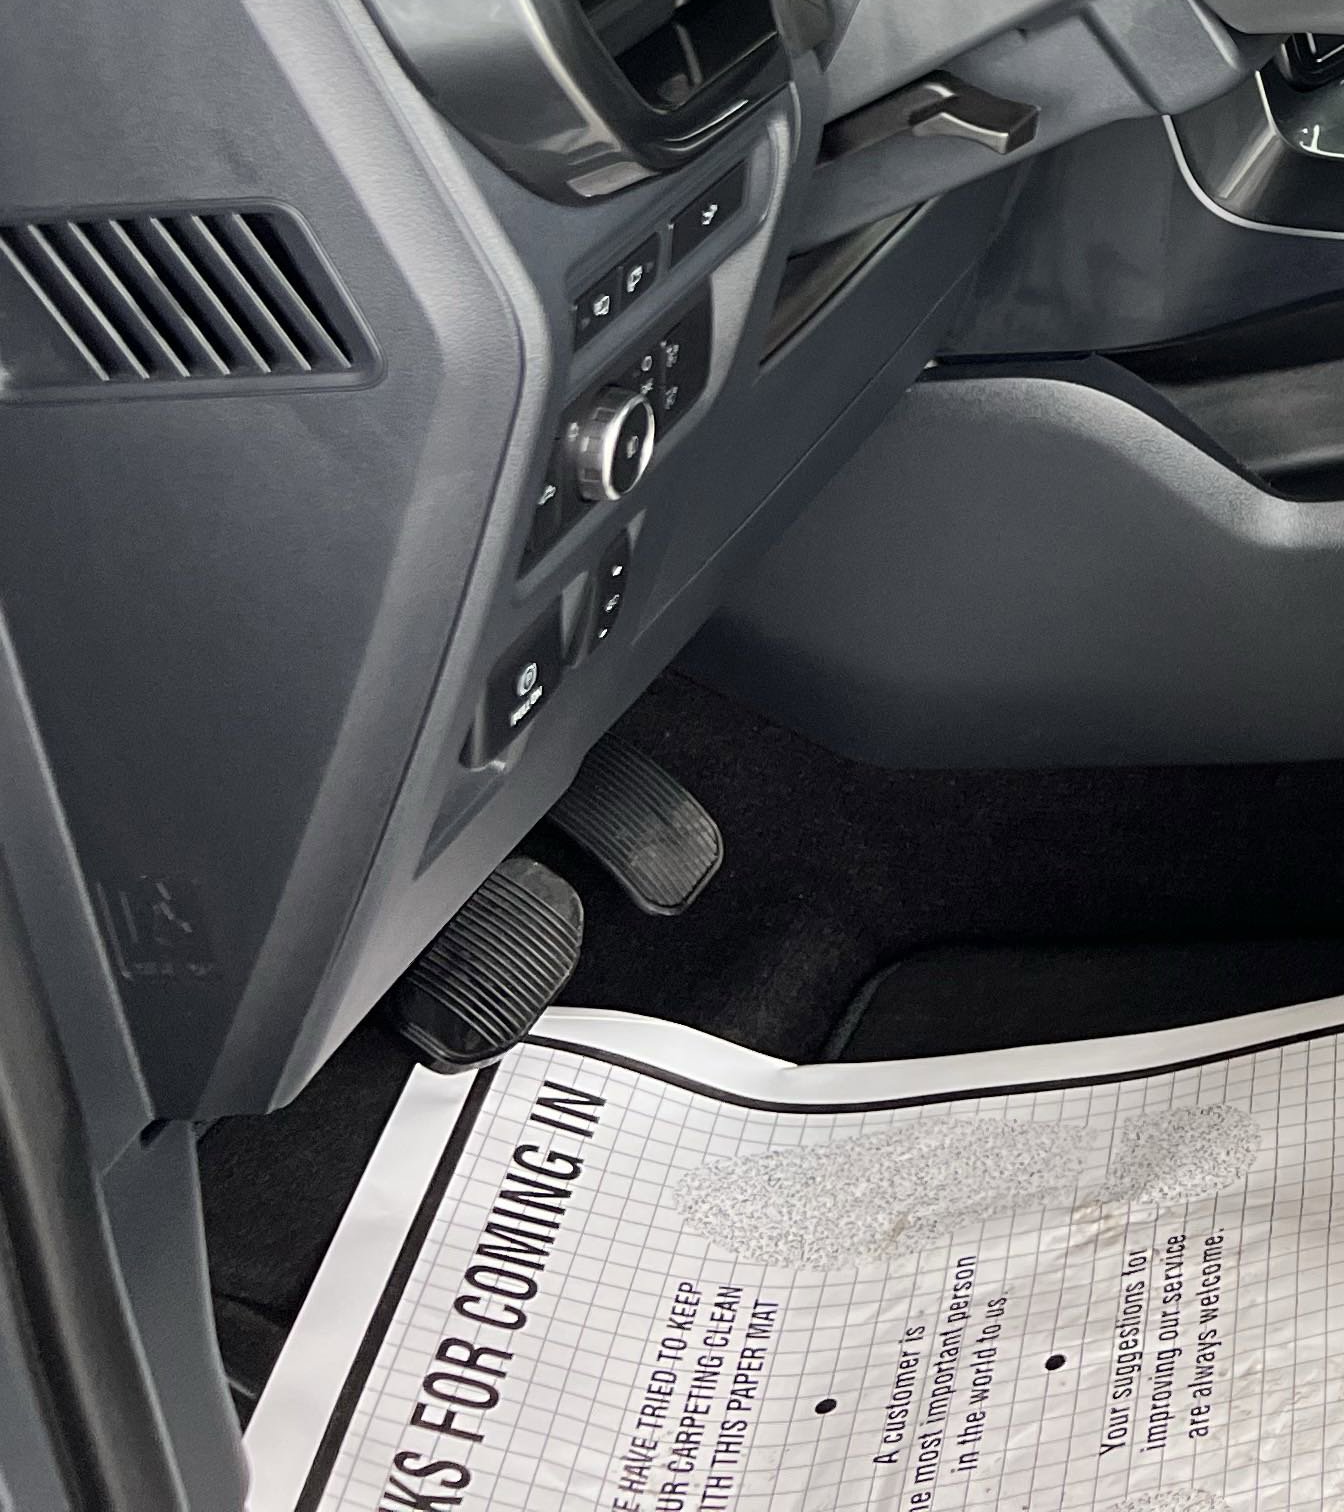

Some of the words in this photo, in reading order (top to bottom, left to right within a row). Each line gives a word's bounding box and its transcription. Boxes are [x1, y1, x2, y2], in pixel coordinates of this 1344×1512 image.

[530, 1079, 607, 1138] IN
[453, 1143, 585, 1330] COMING
[947, 1255, 977, 1324] person
[1160, 1234, 1187, 1305] service
[1195, 1228, 1225, 1325] welcome.
[666, 1281, 702, 1331] KEEP
[703, 1286, 744, 1348] CLEAN
[746, 1298, 779, 1339] MAT
[898, 1325, 926, 1344] is
[976, 1323, 1001, 1344] to
[1158, 1308, 1181, 1341] our
[657, 1337, 688, 1361] TO
[1112, 1280, 1145, 1400] suggestions
[1187, 1328, 1222, 1399] always
[410, 1337, 514, 1443] FOR
[636, 1370, 678, 1428] TRIED
[726, 1347, 768, 1411] PAPER
[883, 1350, 920, 1444] customer
[920, 1327, 963, 1427] important
[969, 1347, 997, 1406] world
[1140, 1348, 1183, 1452] improving
[667, 1354, 724, 1473] CARPETING
[957, 1410, 986, 1445] the
[1099, 1407, 1131, 1457] Your
[1188, 1404, 1211, 1440] are
[618, 1436, 658, 1494] HAVE
[711, 1419, 748, 1468] THIS
[872, 1451, 899, 1464] A
[914, 1428, 943, 1483] most
[950, 1450, 980, 1473] in
[379, 1451, 471, 1512] KS
[611, 1497, 641, 1512] E
[655, 1482, 689, 1512] UR
[698, 1476, 735, 1512] ITH
